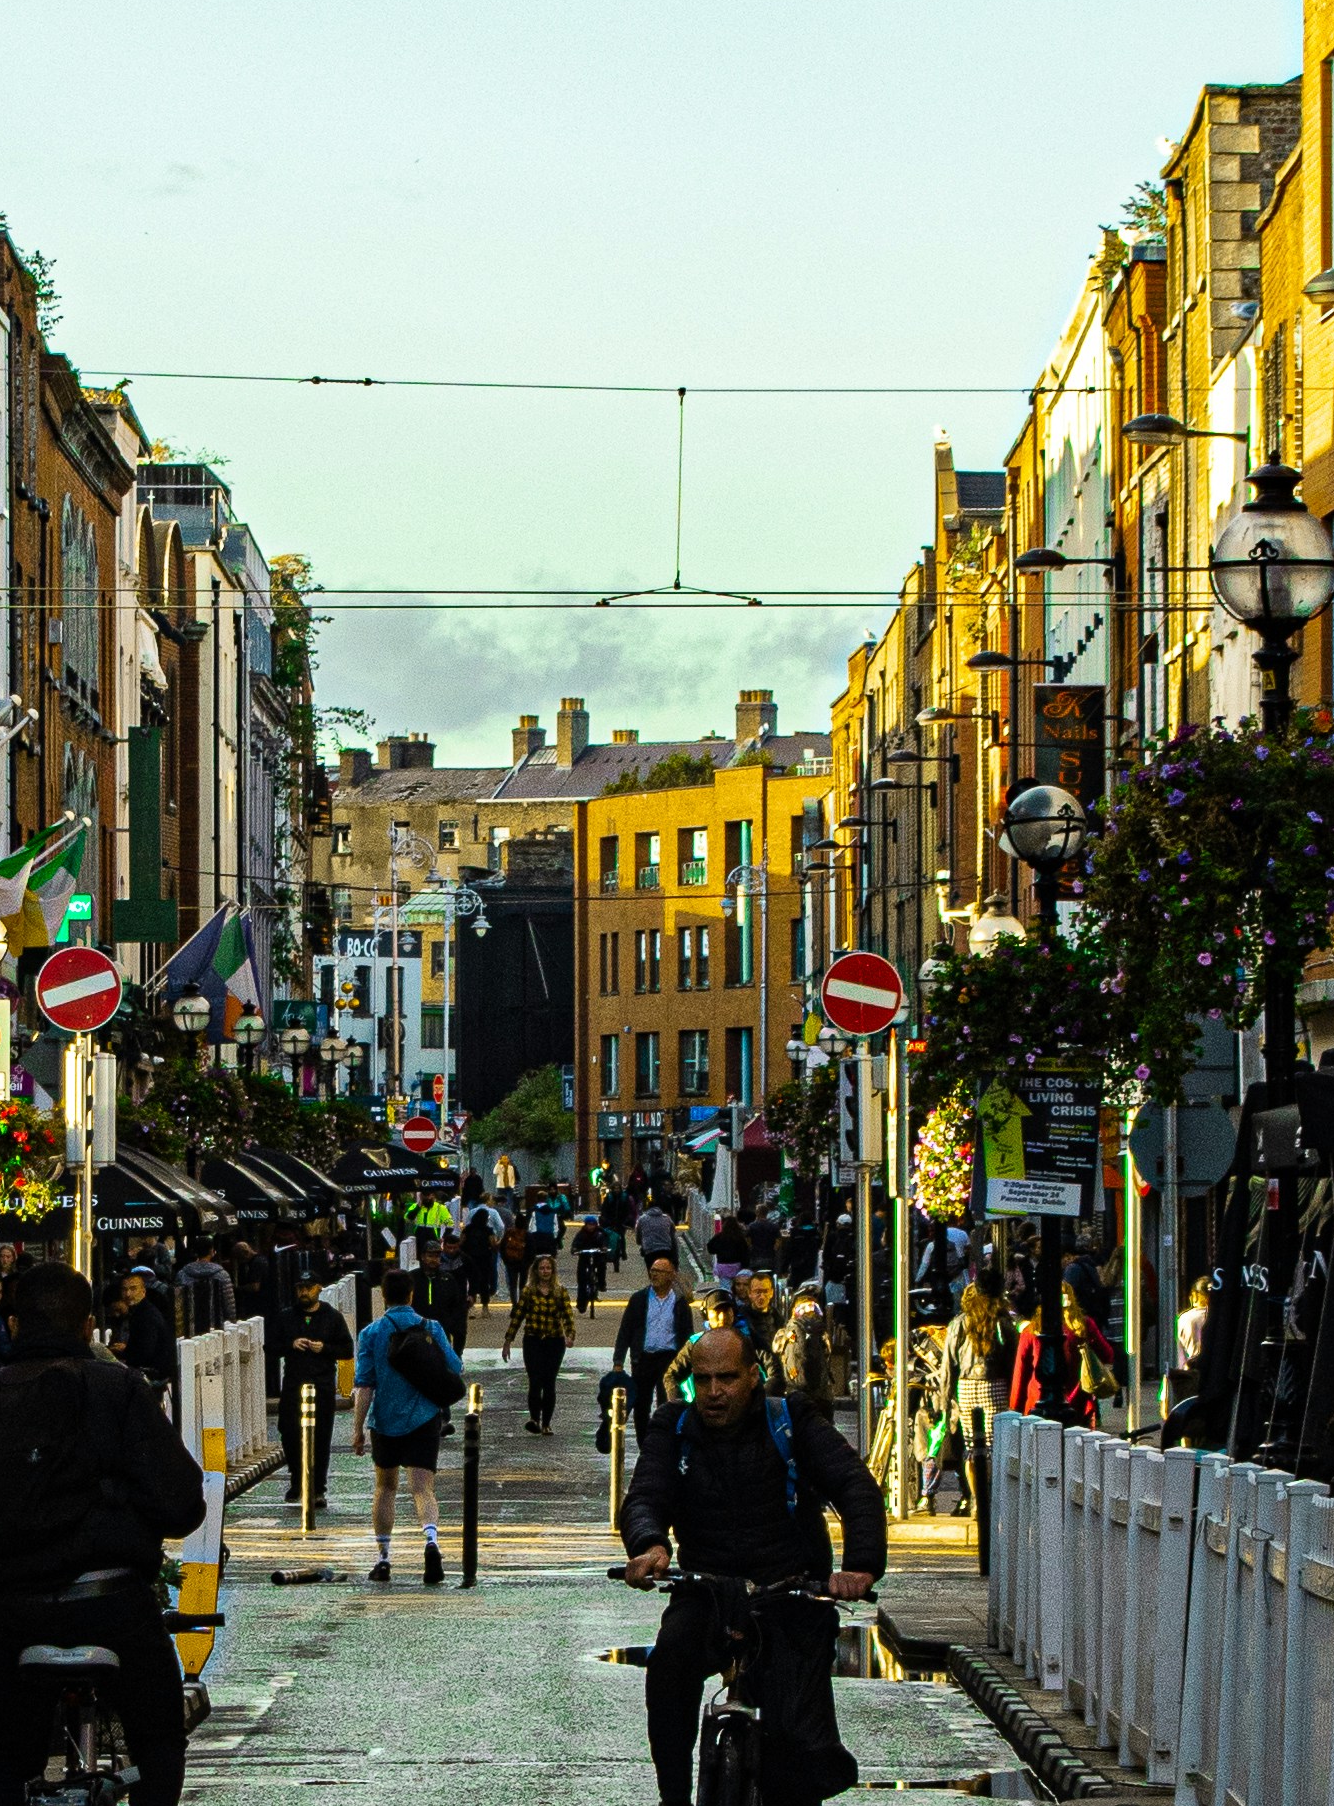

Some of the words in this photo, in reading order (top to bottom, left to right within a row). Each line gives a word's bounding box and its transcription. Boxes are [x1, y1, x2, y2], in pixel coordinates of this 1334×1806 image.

[1043, 724, 1098, 740] Nails
[1028, 1092, 1075, 1103] LIVING
[1051, 1105, 1097, 1116] CRISIS
[363, 1168, 419, 1177] GUINNESS
[421, 1179, 455, 1188] GUINNESS
[1032, 1182, 1065, 1192] Saturday
[1008, 1188, 1049, 1197] September
[1000, 1195, 1028, 1203] Parnell
[1041, 1198, 1067, 1206] Dublin
[97, 1216, 163, 1231] GUINNESS
